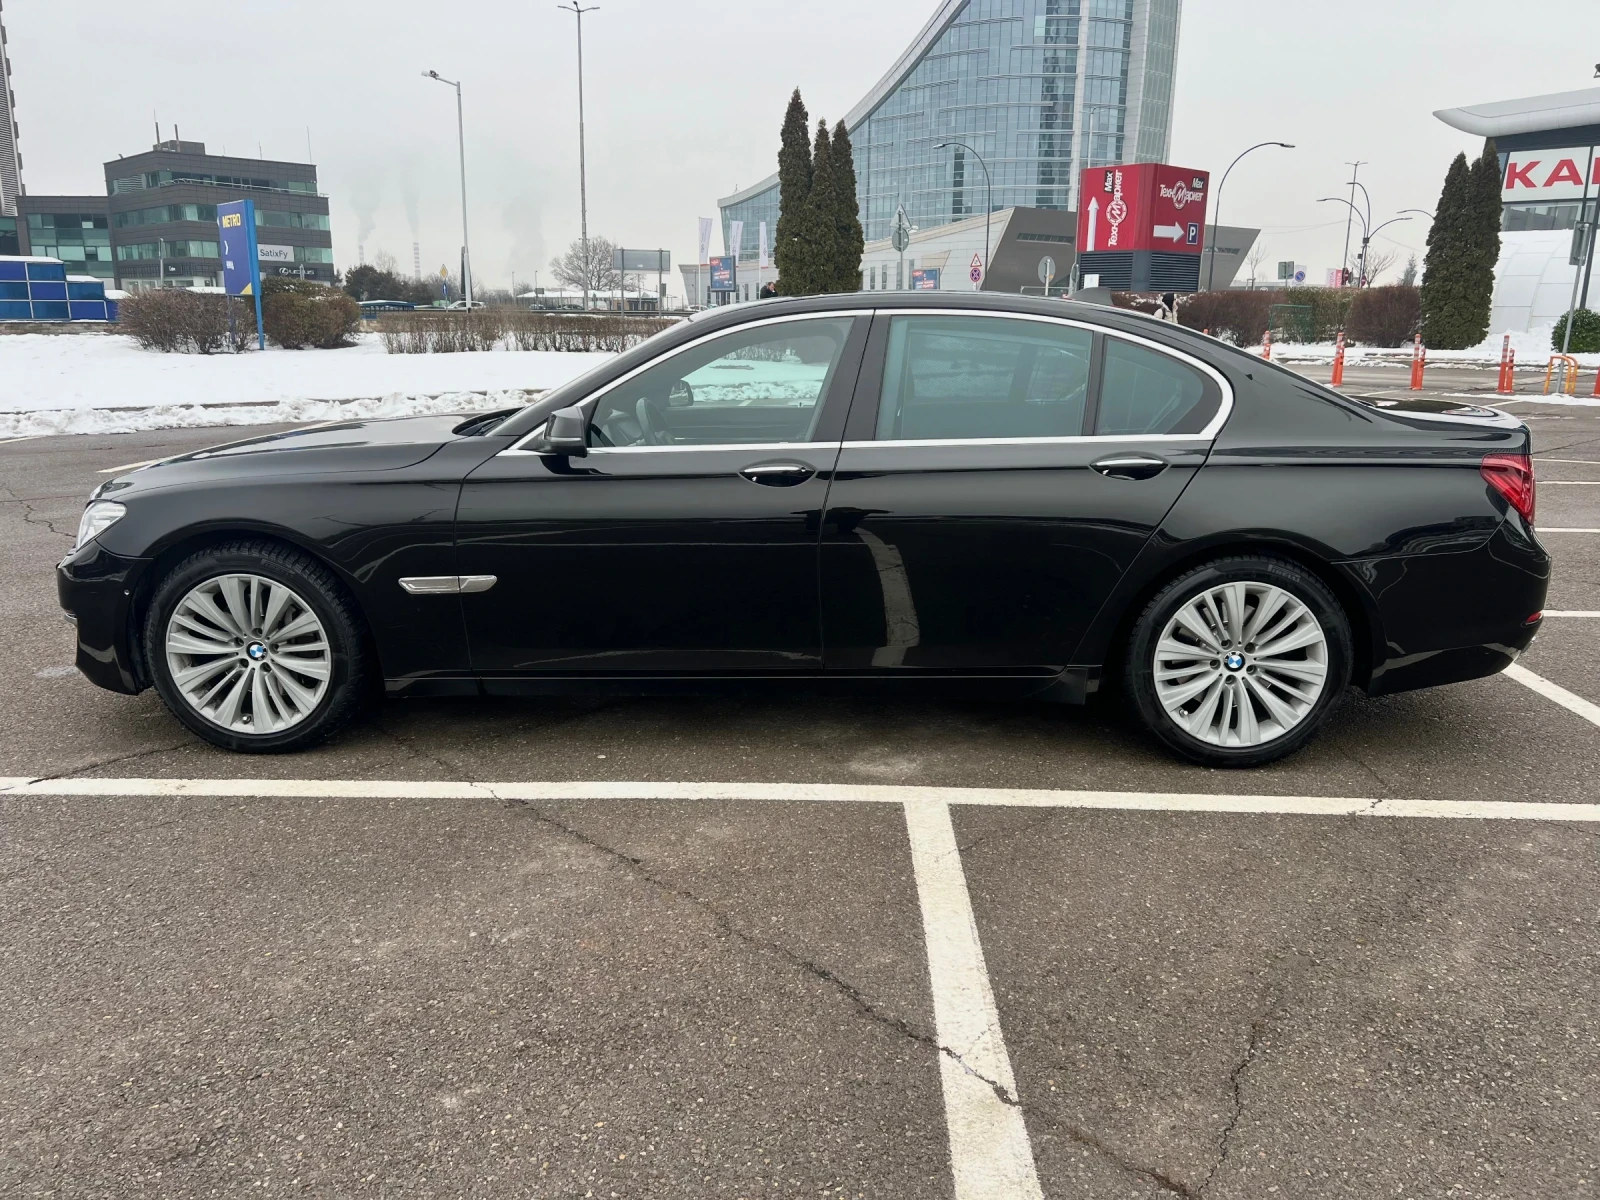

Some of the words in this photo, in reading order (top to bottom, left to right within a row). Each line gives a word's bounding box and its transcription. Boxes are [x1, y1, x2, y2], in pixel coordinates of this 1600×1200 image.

[1505, 157, 1600, 190] KA
[1104, 172, 1113, 192] Max
[1192, 177, 1204, 189] Max
[222, 213, 241, 228] METRO
[1189, 226, 1196, 241] P
[259, 248, 288, 260] SatixFy
